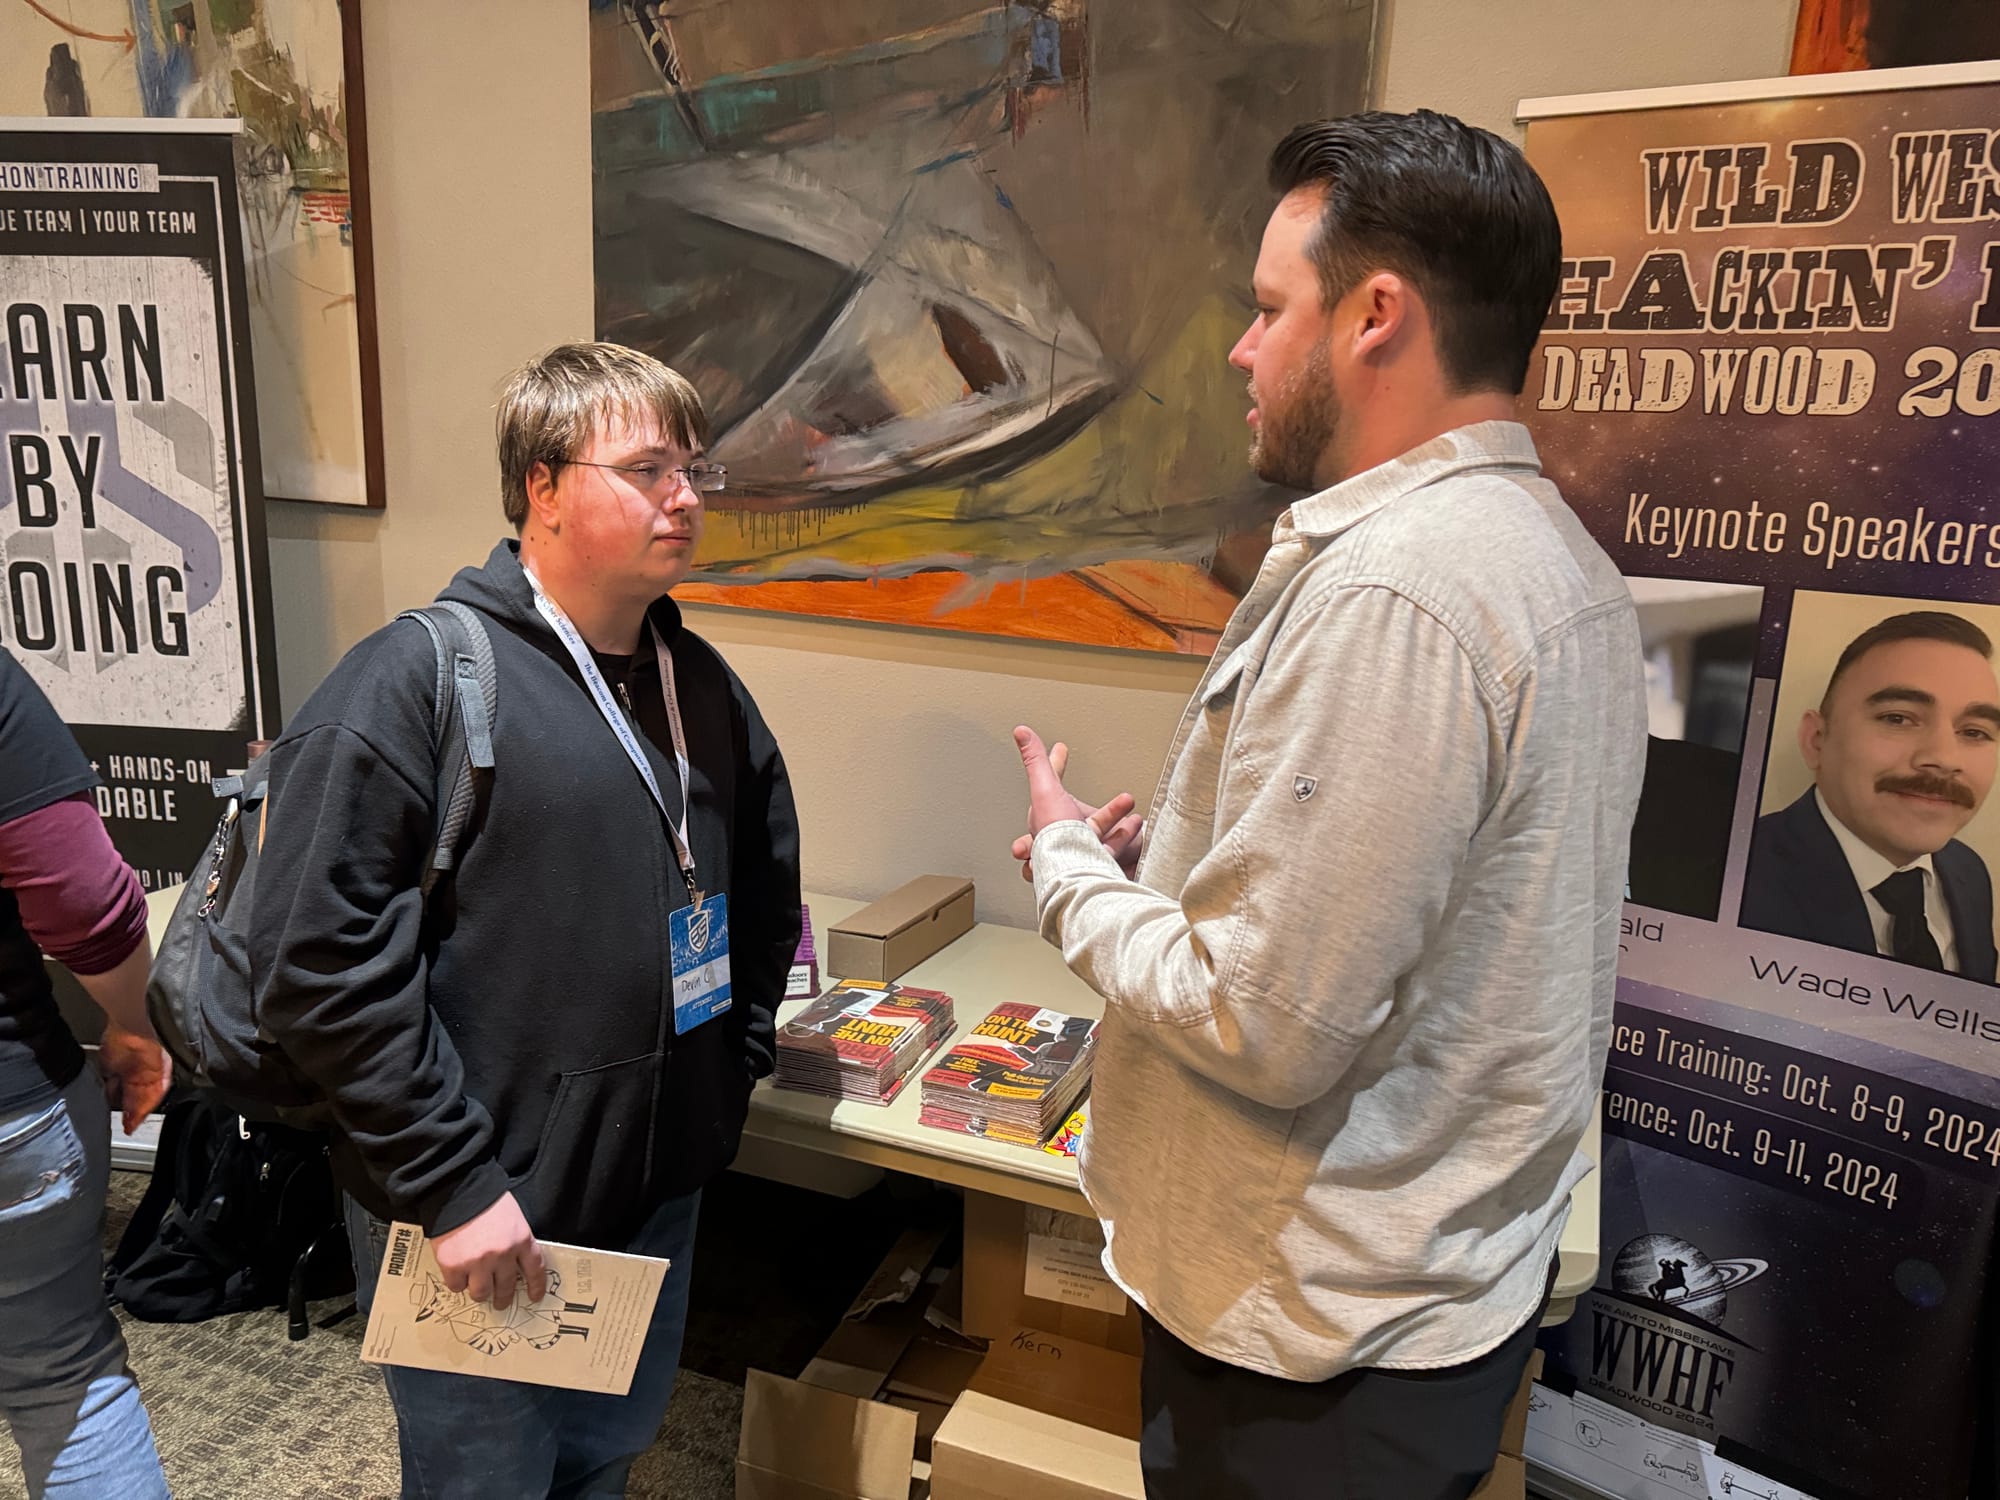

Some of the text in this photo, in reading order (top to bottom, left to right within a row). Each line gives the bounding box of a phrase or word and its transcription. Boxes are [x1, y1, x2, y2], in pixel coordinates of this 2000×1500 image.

[44, 167, 138, 189] TRAINING
[1640, 137, 1866, 234] WILD
[24, 209, 72, 232] TEAM
[92, 210, 140, 233] YOUR
[146, 211, 197, 234] TEAM
[0, 303, 165, 401] ARN
[1537, 346, 1876, 416] DEADWOOD
[9, 435, 101, 529] BY
[1624, 493, 2000, 570] Keynote Speakers
[0, 561, 189, 656] OING
[554, 616, 578, 645] Sciences
[583, 660, 595, 676] The
[603, 700, 624, 728] College
[621, 732, 645, 767] Computer
[109, 755, 211, 784] HANDS-ON
[91, 786, 177, 821] DABLE
[984, 1014, 1012, 1026] ON
[1750, 955, 2000, 1042] Wade Wells
[831, 1028, 895, 1046] ON THE
[842, 1018, 906, 1038] HUNT
[971, 1022, 1037, 1046] HUNT
[1657, 1028, 1772, 1095] Training:
[1782, 1063, 1837, 1114] Oct.
[1850, 1084, 1911, 1141] 8-9,
[1924, 1107, 2000, 1167] 2024
[1687, 1108, 1741, 1158] Oct.
[1753, 1129, 1813, 1185] 9-11,
[1824, 1151, 1898, 1209] 2024
[387, 1228, 413, 1277] PROMPT#
[1010, 1330, 1063, 1360] Kern
[1592, 1301, 1736, 1358] WE AIM TO MISBEHAVE
[1591, 1309, 1735, 1420] WWHF
[1588, 1375, 1673, 1416] DEADWOOD
[1674, 1409, 1715, 1431] 2024
